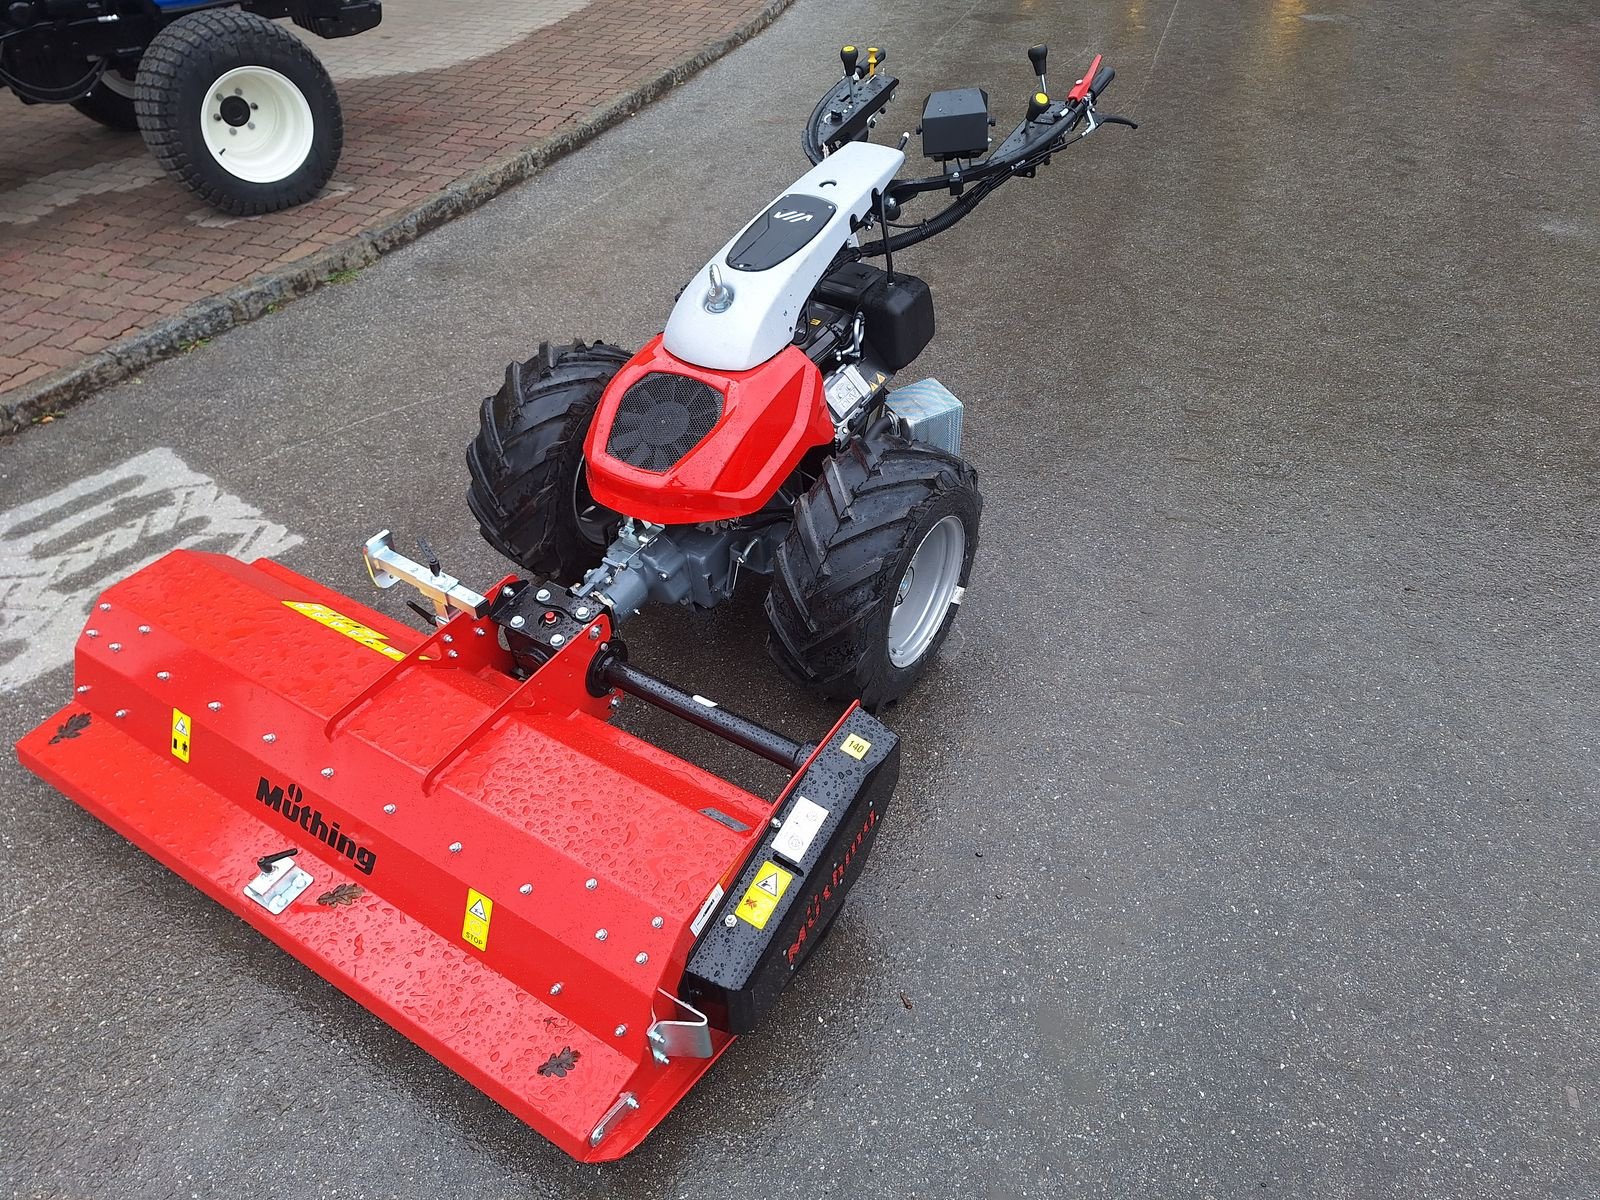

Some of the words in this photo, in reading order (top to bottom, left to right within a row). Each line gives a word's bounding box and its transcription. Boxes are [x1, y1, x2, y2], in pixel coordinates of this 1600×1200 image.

[848, 740, 865, 753] 140
[256, 776, 377, 876] Müthing
[465, 931, 483, 945] STOP
